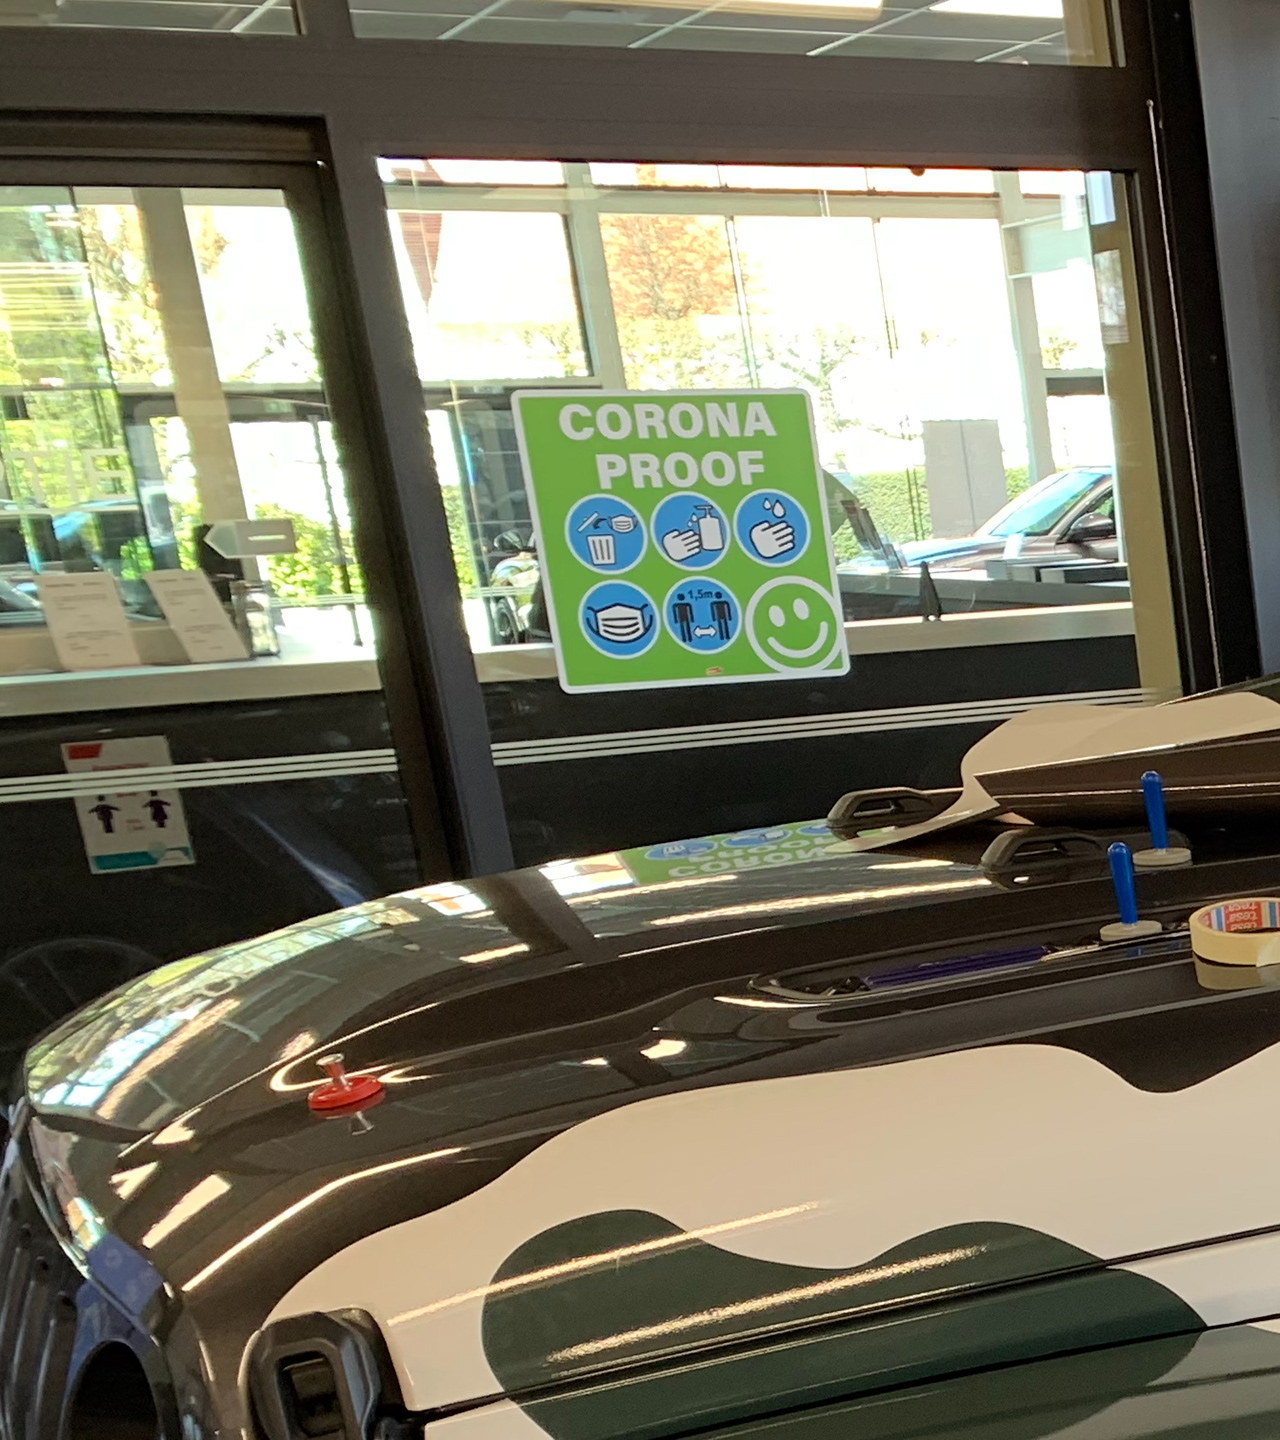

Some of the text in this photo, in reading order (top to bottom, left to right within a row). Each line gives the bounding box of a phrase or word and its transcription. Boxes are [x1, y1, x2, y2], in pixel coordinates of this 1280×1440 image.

[558, 401, 778, 442] CORONA
[595, 450, 766, 490] PROOF
[688, 589, 713, 601] 1,5m
[1229, 911, 1258, 921] tesa
